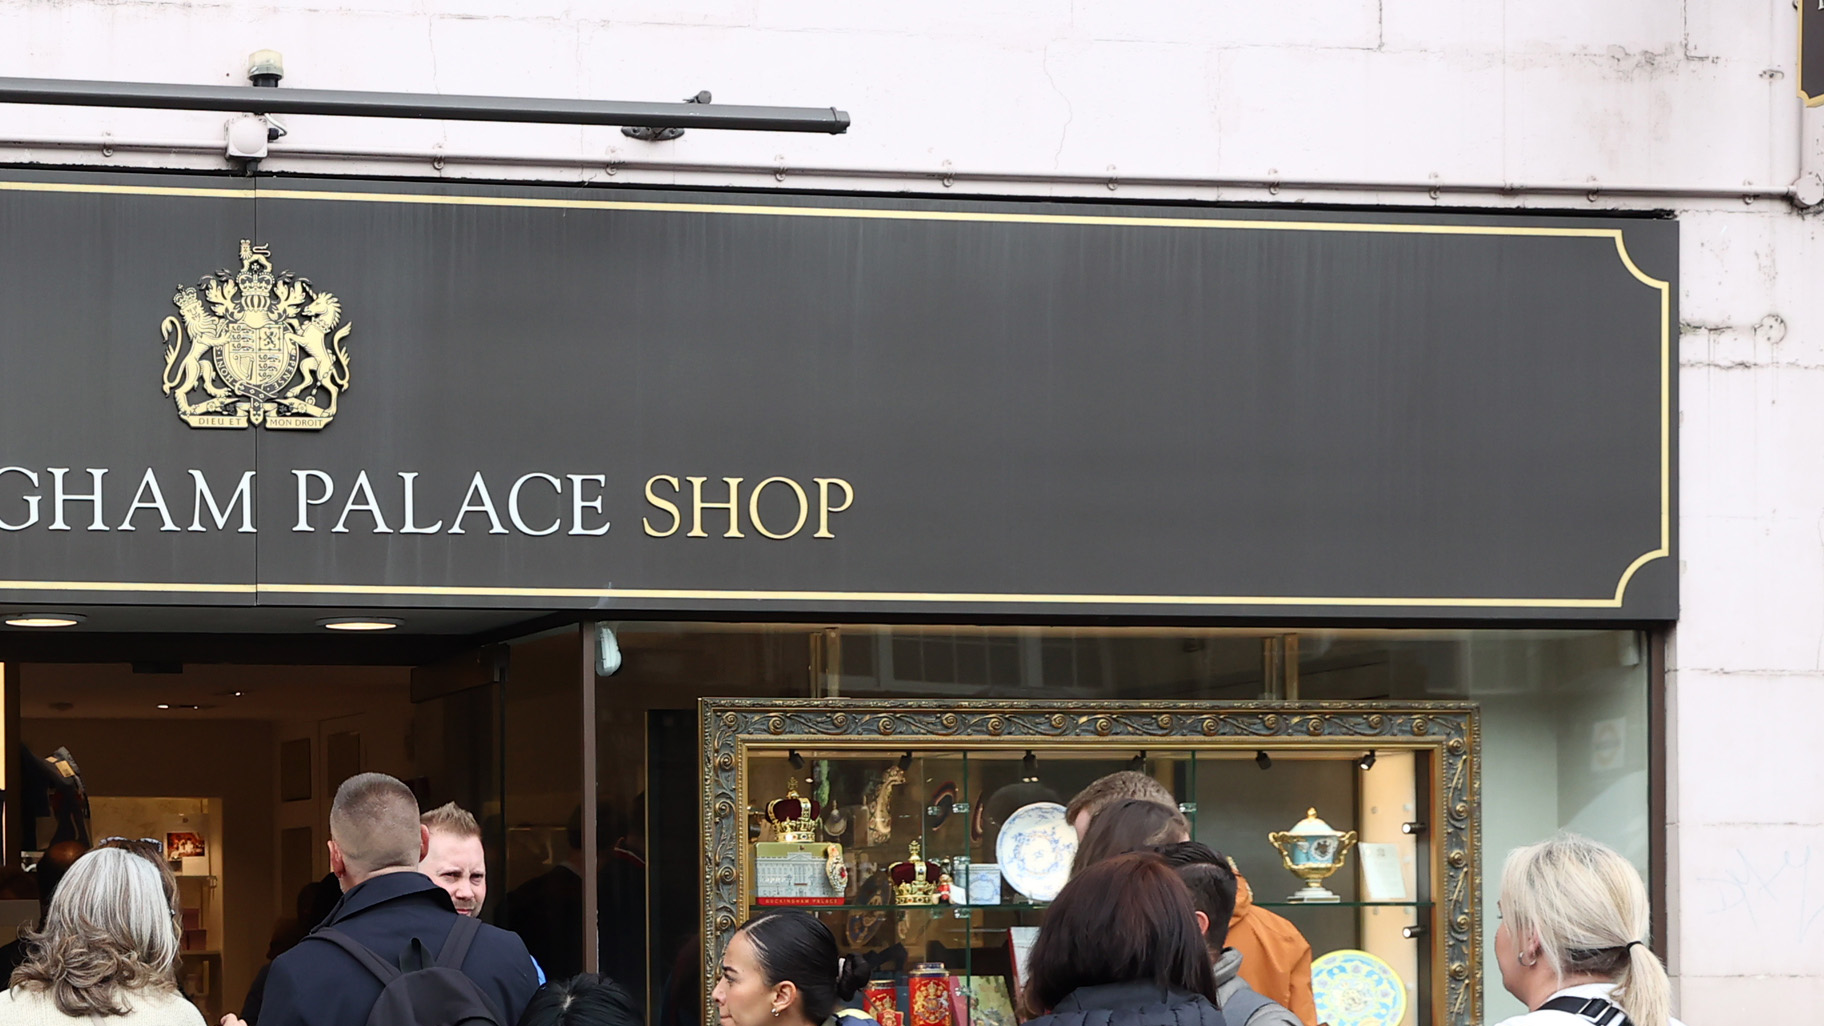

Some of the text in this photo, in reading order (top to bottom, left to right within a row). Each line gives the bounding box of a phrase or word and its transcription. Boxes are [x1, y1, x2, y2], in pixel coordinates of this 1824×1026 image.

[198, 417, 324, 427] DIEU ET MON DROIT
[290, 469, 611, 537] PALACE
[642, 474, 855, 540] SHOP
